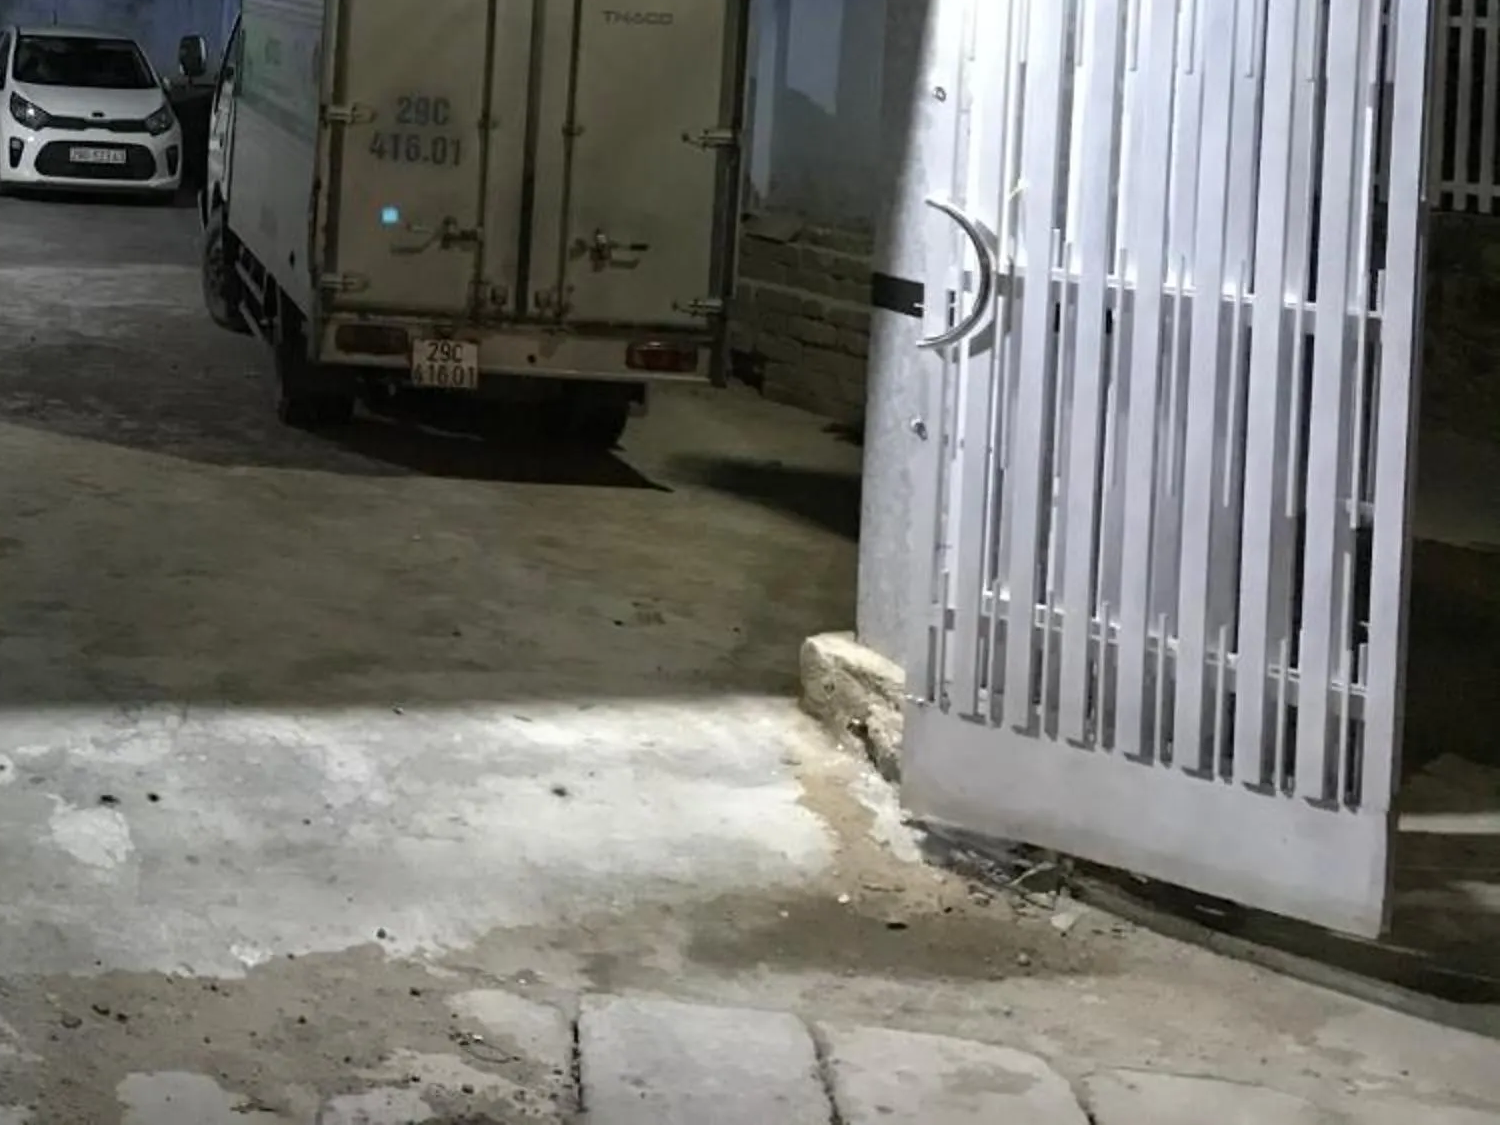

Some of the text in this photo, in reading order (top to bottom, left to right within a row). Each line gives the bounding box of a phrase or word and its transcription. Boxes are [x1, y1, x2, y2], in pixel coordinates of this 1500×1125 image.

[601, 8, 675, 27] THACO
[395, 95, 451, 126] 29C
[426, 341, 463, 363] 29C
